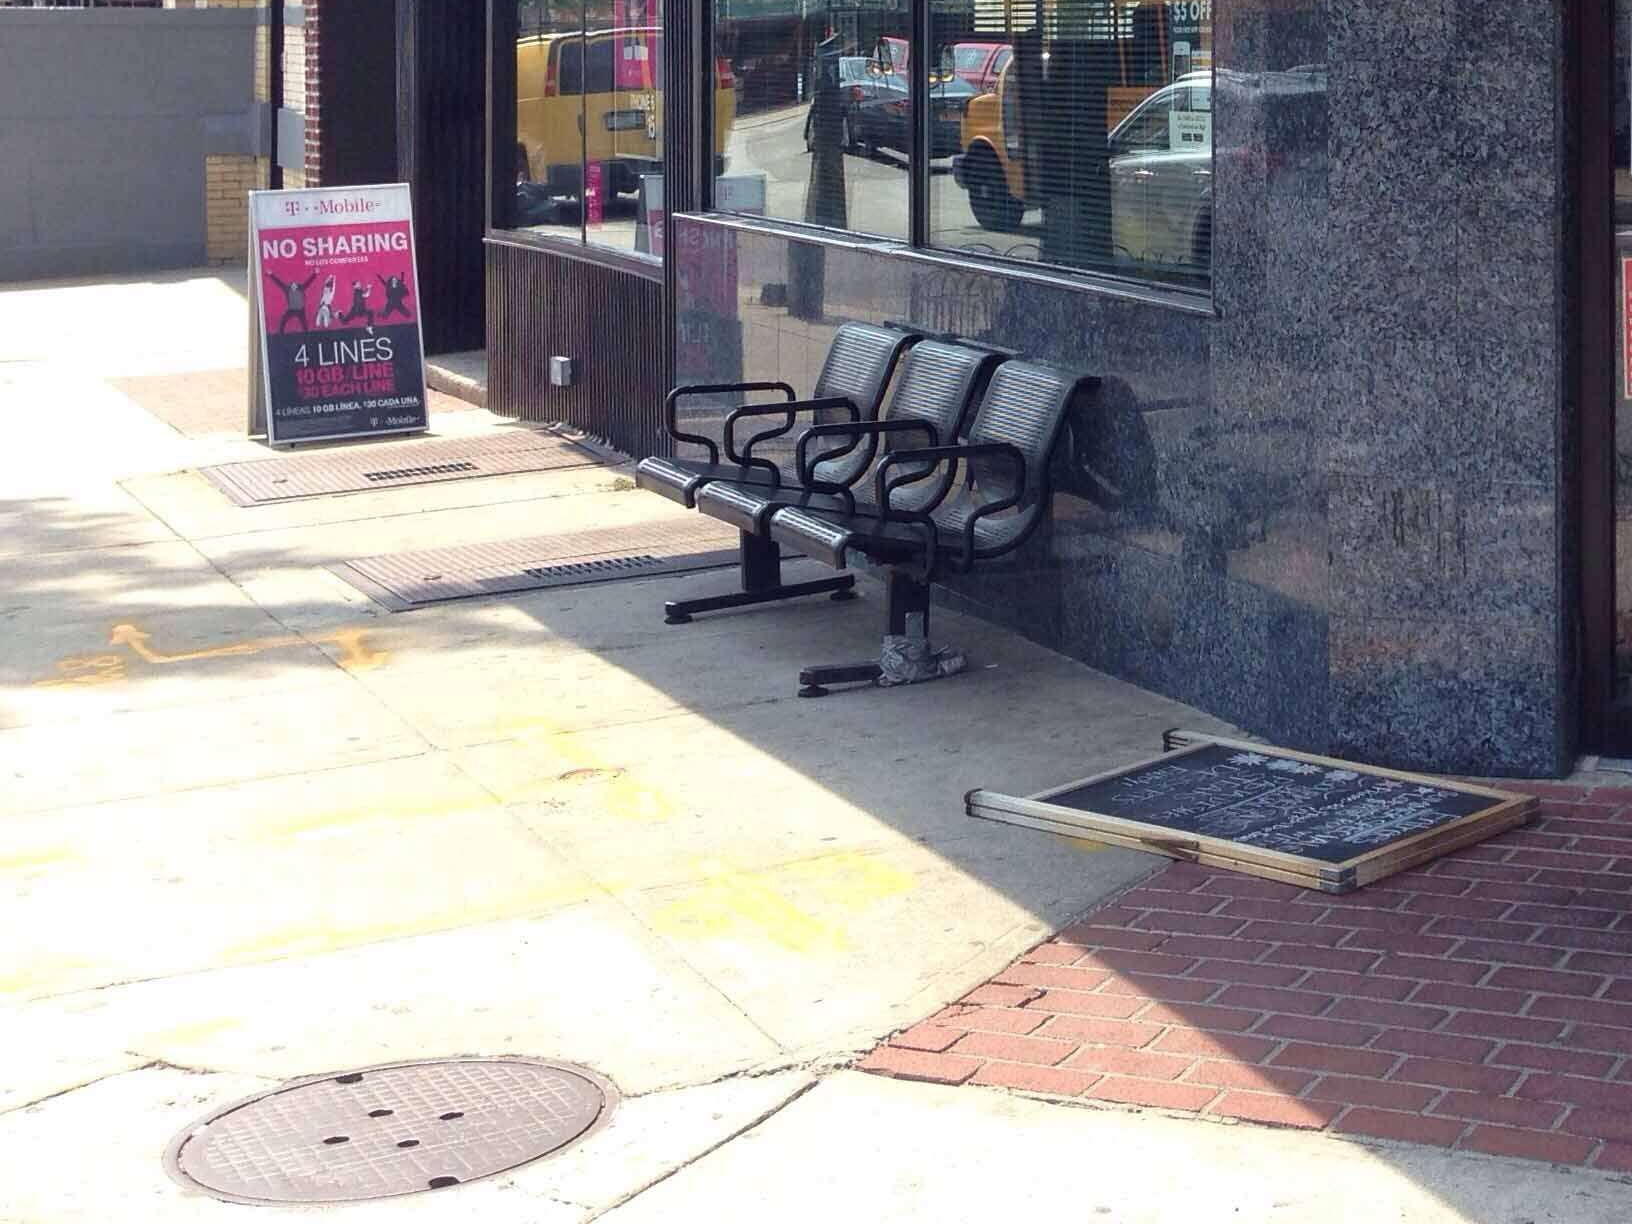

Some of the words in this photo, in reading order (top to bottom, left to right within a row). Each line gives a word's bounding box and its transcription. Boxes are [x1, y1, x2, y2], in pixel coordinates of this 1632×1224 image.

[1173, 1, 1188, 21] $5
[263, 239, 297, 259] NO
[302, 232, 408, 257] SHARING
[294, 344, 310, 368] 4
[318, 337, 393, 366] LINES
[296, 369, 314, 385] 10
[352, 362, 394, 381] LINE
[364, 379, 395, 394] LINE
